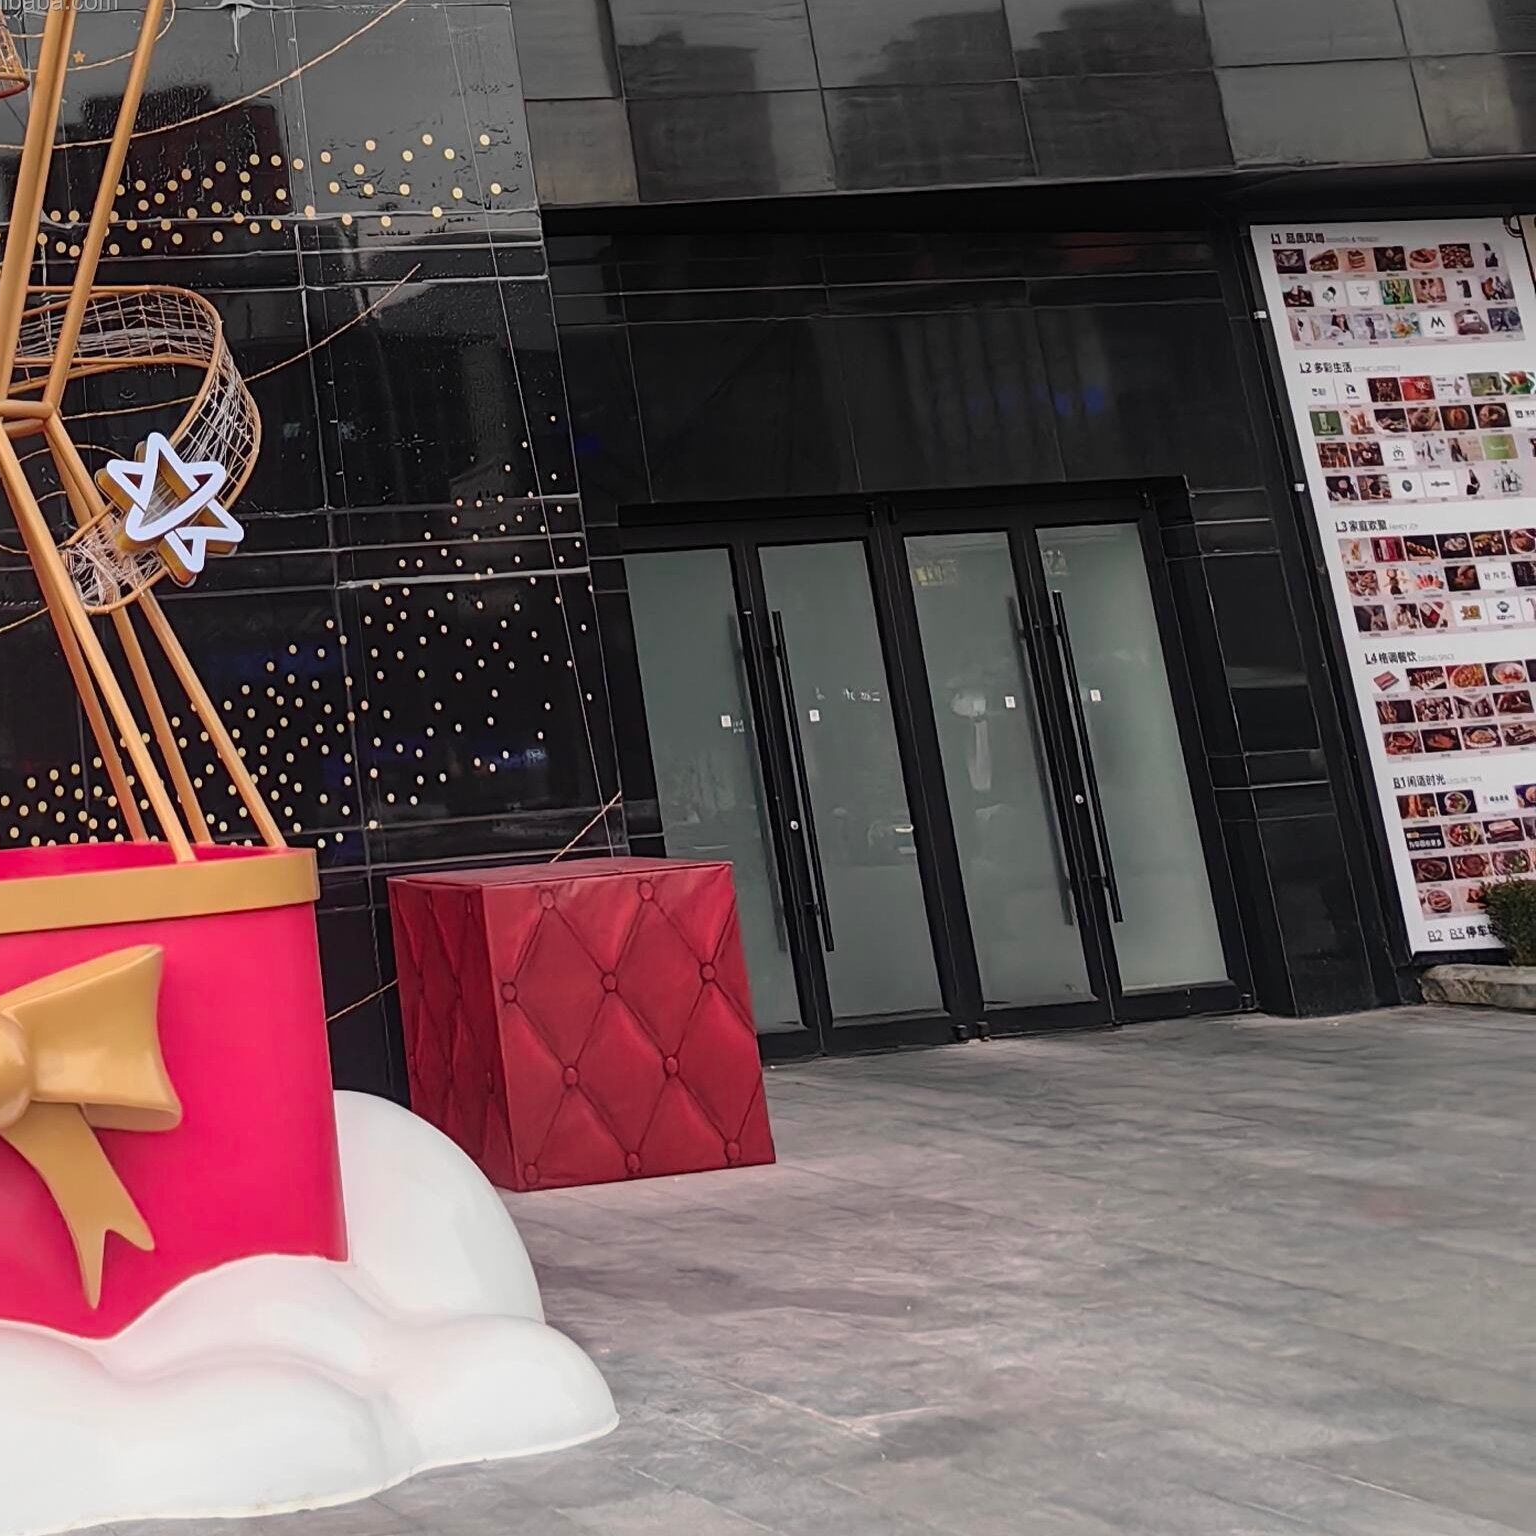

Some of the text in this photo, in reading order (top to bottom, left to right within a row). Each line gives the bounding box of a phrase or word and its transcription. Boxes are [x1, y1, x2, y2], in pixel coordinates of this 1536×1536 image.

[1299, 362, 1312, 374] L2
[1314, 361, 1352, 374] 多彩生活
[1335, 520, 1348, 533] L3
